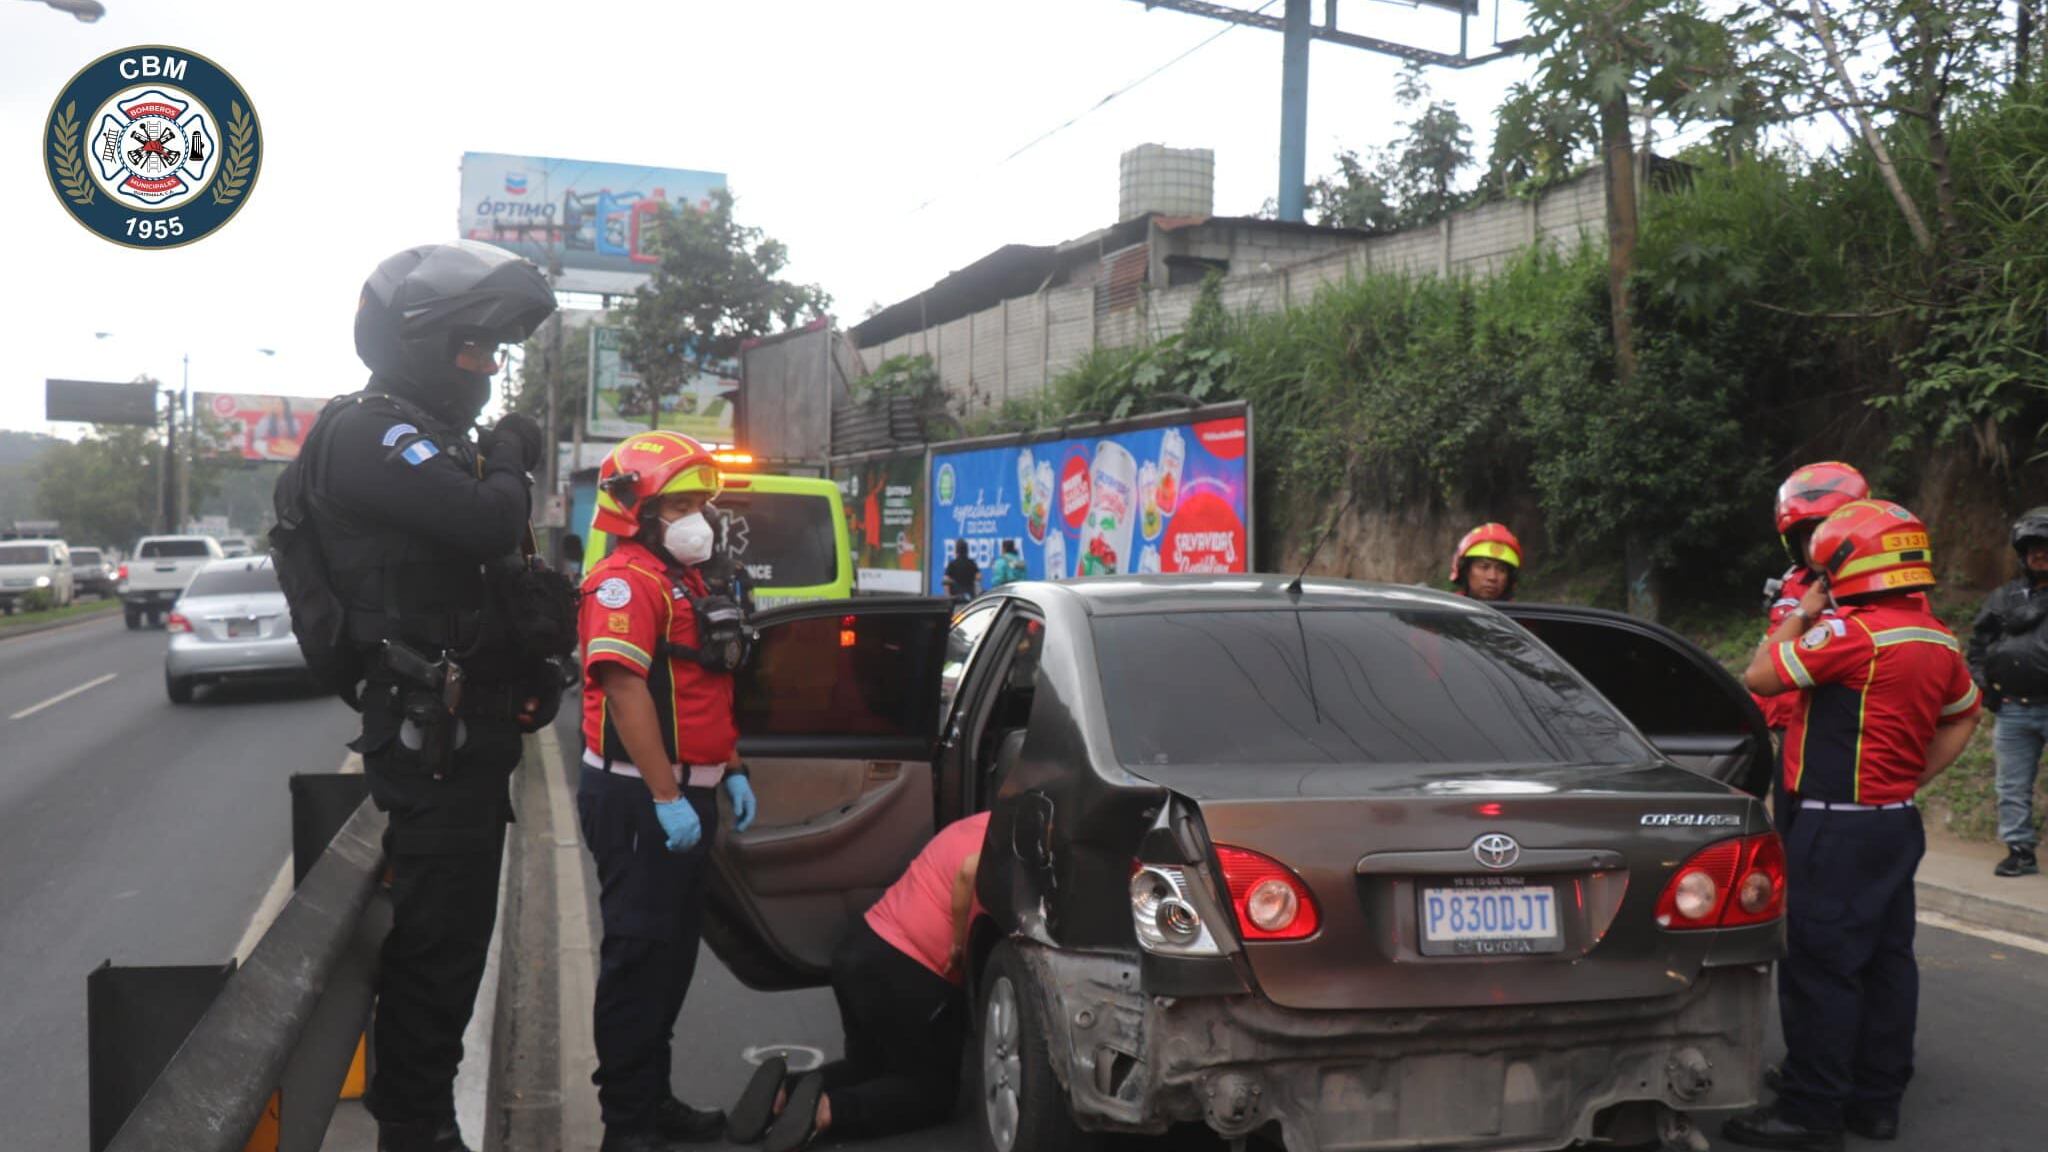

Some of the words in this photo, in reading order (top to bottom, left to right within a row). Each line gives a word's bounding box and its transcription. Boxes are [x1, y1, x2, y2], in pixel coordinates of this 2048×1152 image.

[476, 195, 556, 217] ÓPTIMO
[631, 441, 666, 455] CBM
[1476, 940, 1531, 953] TOYOTA
